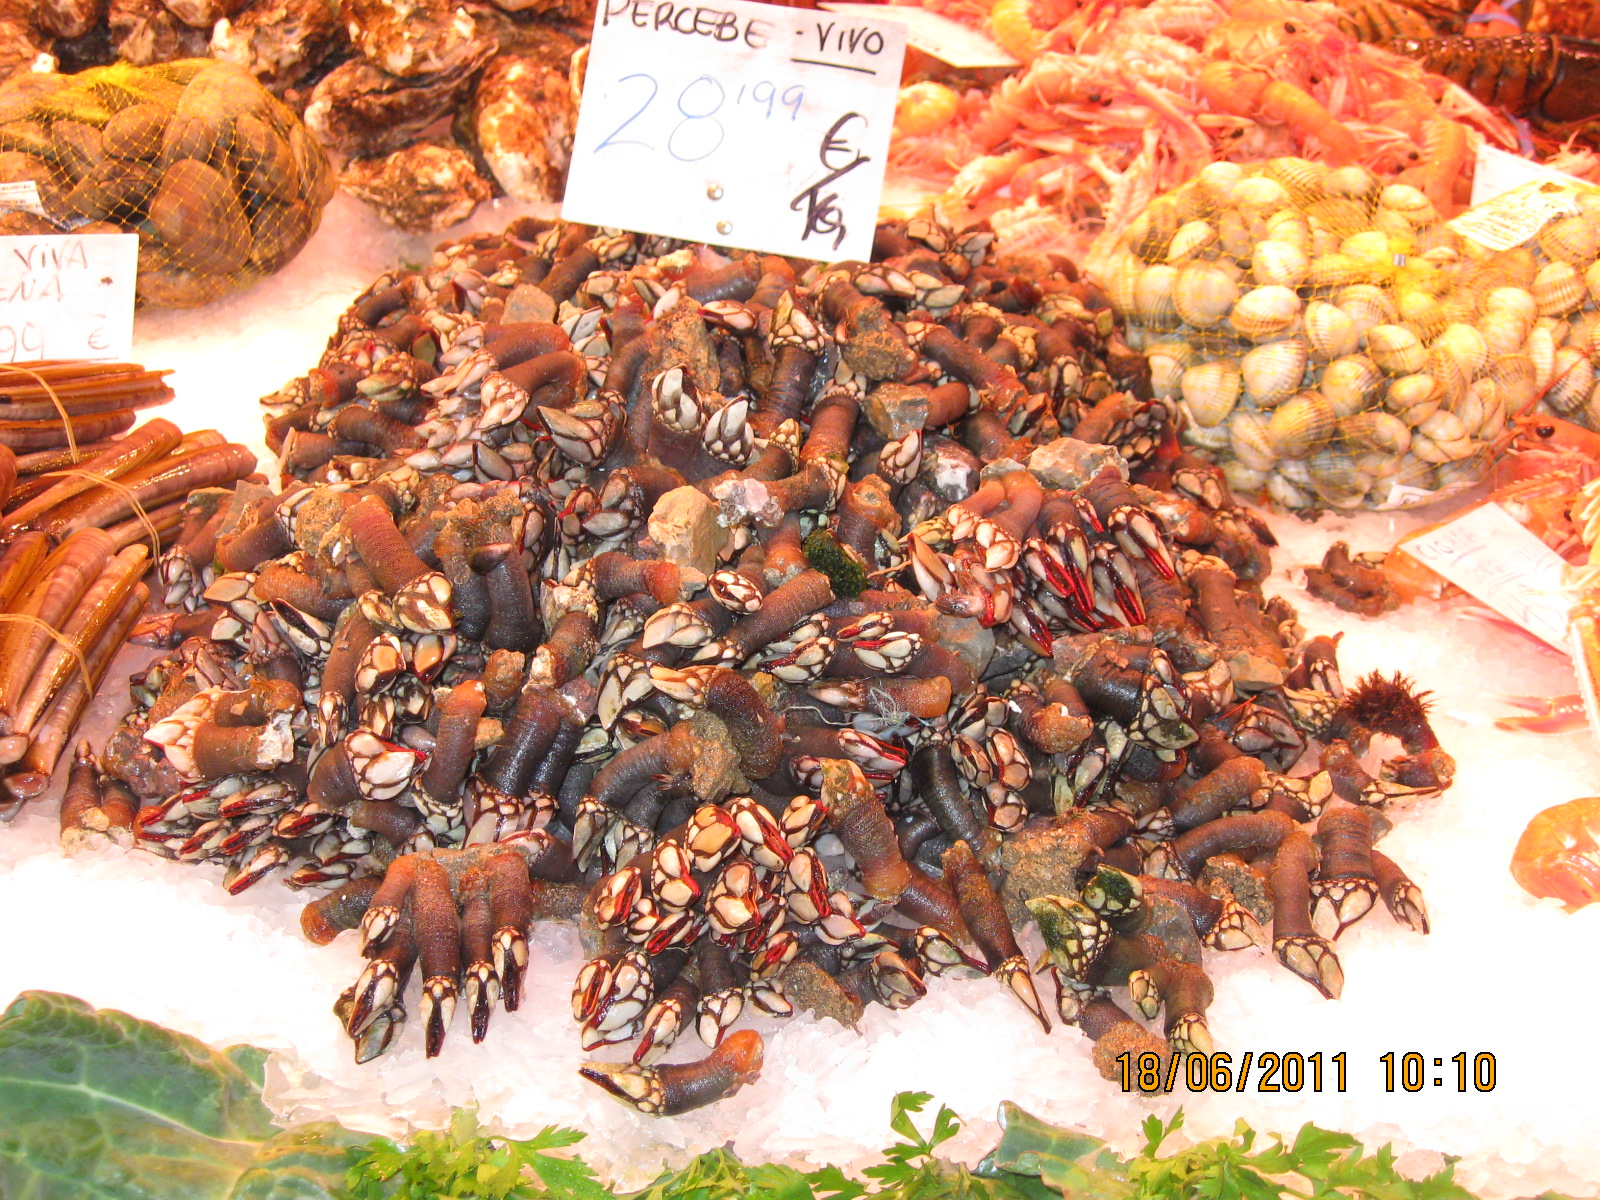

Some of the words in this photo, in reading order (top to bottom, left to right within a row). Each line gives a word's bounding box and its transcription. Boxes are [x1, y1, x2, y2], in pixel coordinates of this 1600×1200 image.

[602, 0, 776, 49] PERCEBE
[817, 22, 885, 55] VIVO
[87, 326, 110, 350] €
